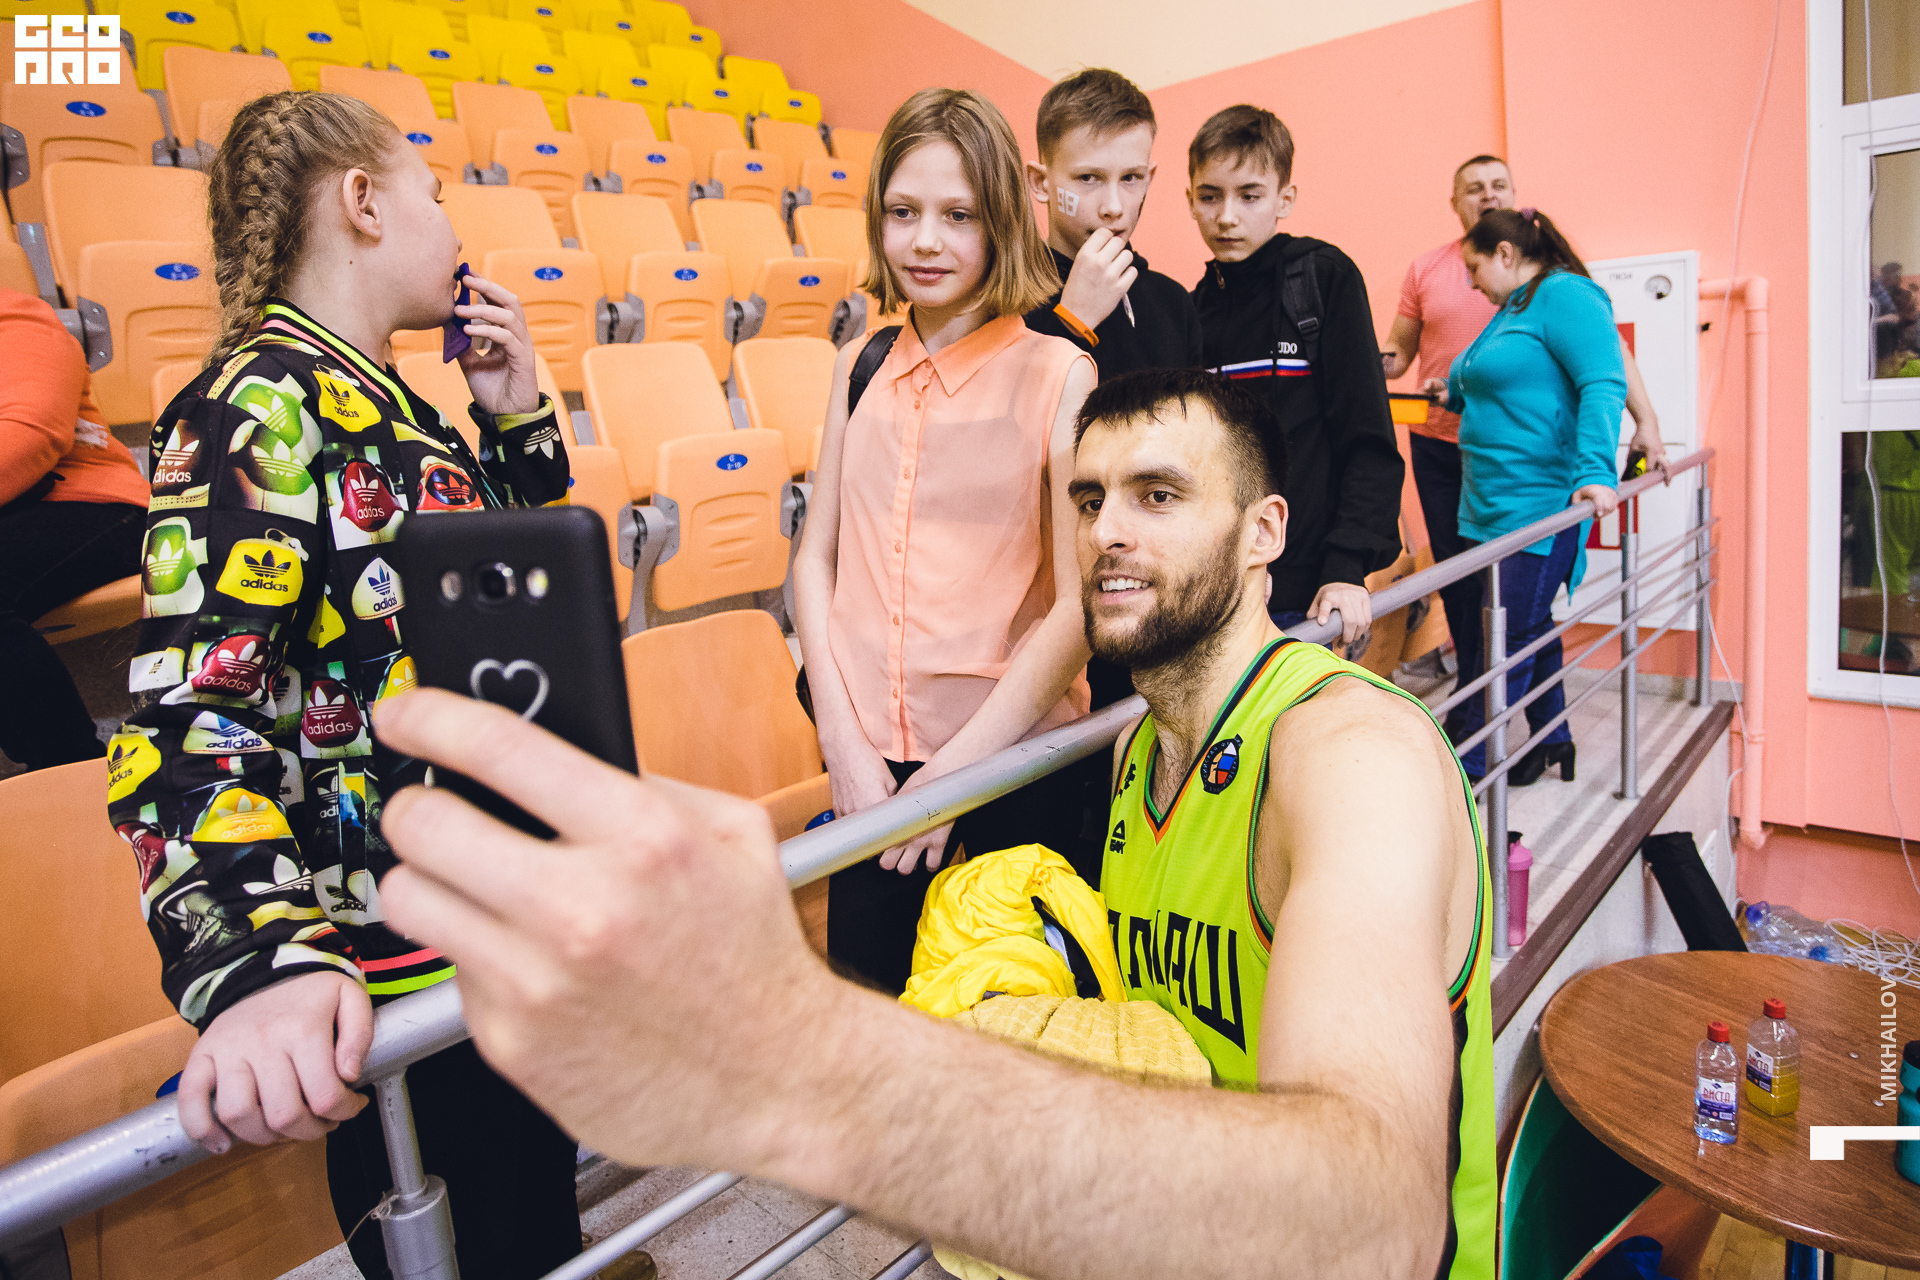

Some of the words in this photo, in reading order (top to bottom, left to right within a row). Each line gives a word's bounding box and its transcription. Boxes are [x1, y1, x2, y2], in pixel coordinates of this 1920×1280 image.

[1277, 342, 1298, 355] UDO
[153, 469, 192, 484] didas
[357, 505, 385, 519] addas
[240, 577, 289, 593] adidas
[202, 675, 252, 692] adidas
[308, 721, 354, 736] adidas
[206, 735, 263, 750] adidas
[221, 823, 275, 840] adidas
